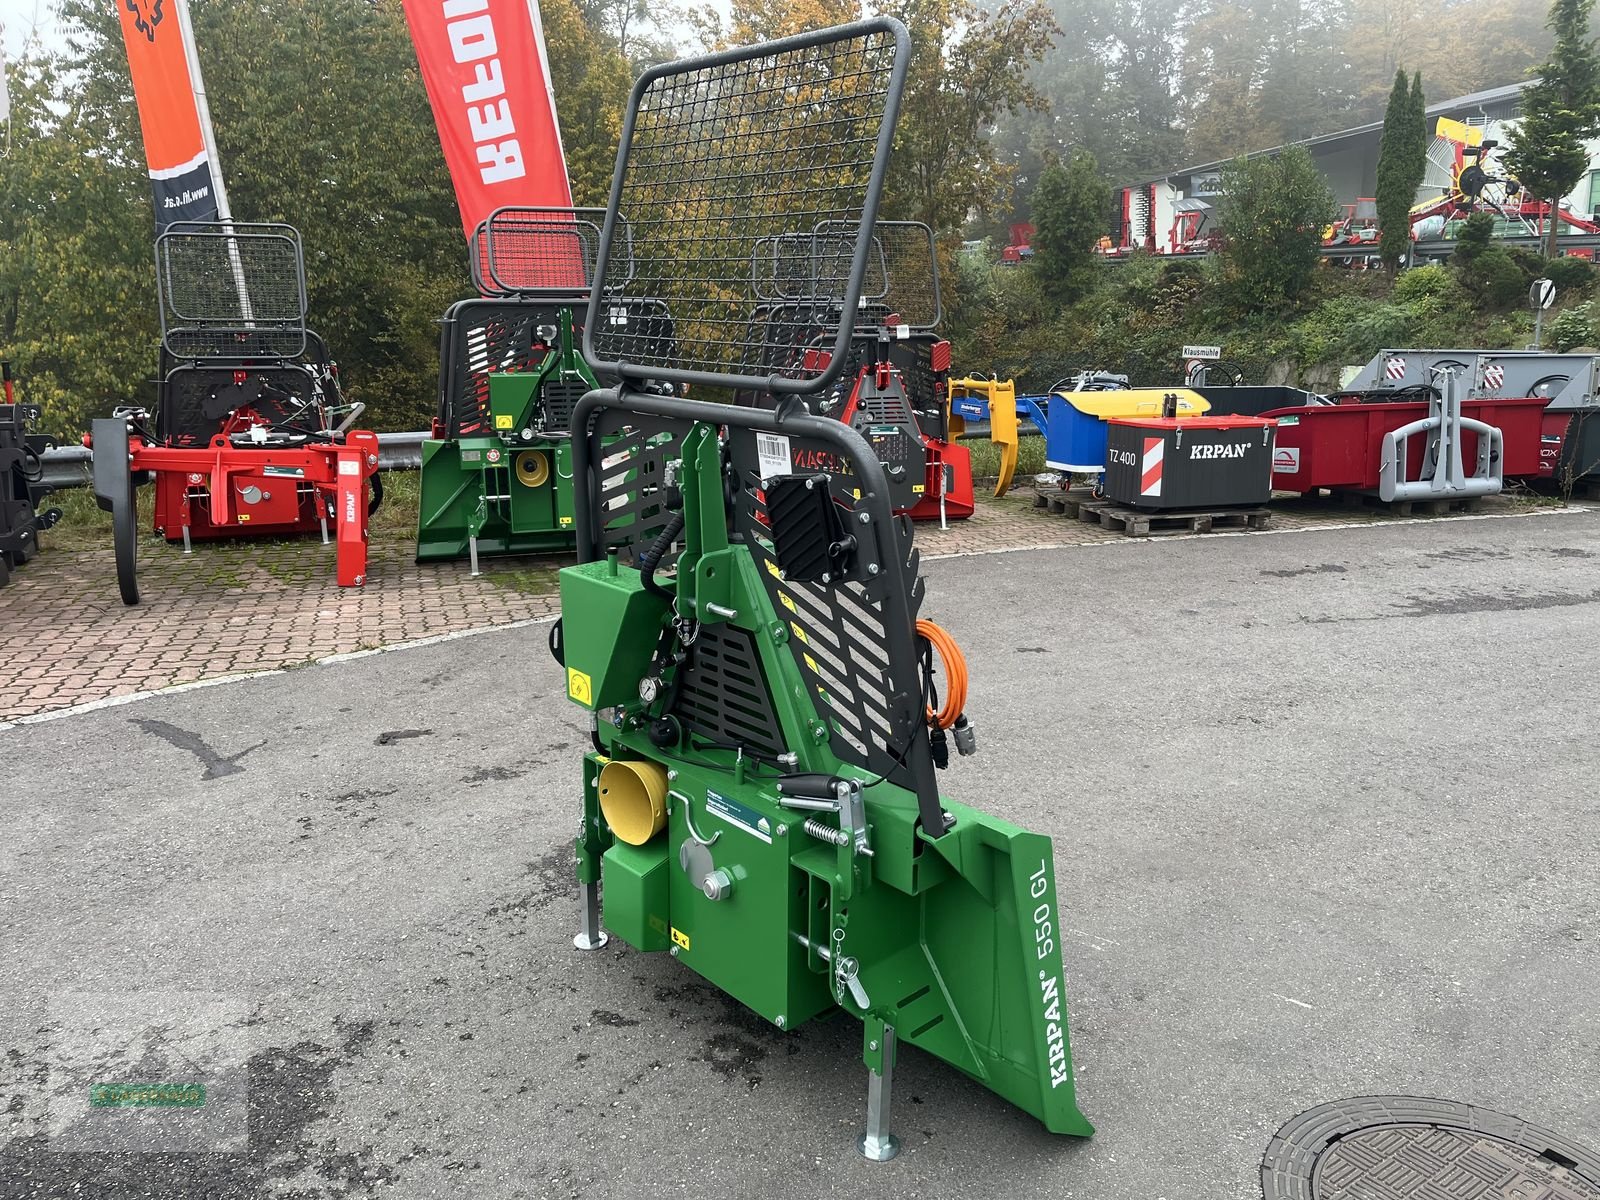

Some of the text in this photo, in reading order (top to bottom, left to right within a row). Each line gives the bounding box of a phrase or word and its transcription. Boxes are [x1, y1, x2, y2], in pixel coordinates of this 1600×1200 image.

[1109, 448, 1136, 466] TZ 400
[1029, 858, 1046, 898] GL
[1033, 903, 1054, 960] 550
